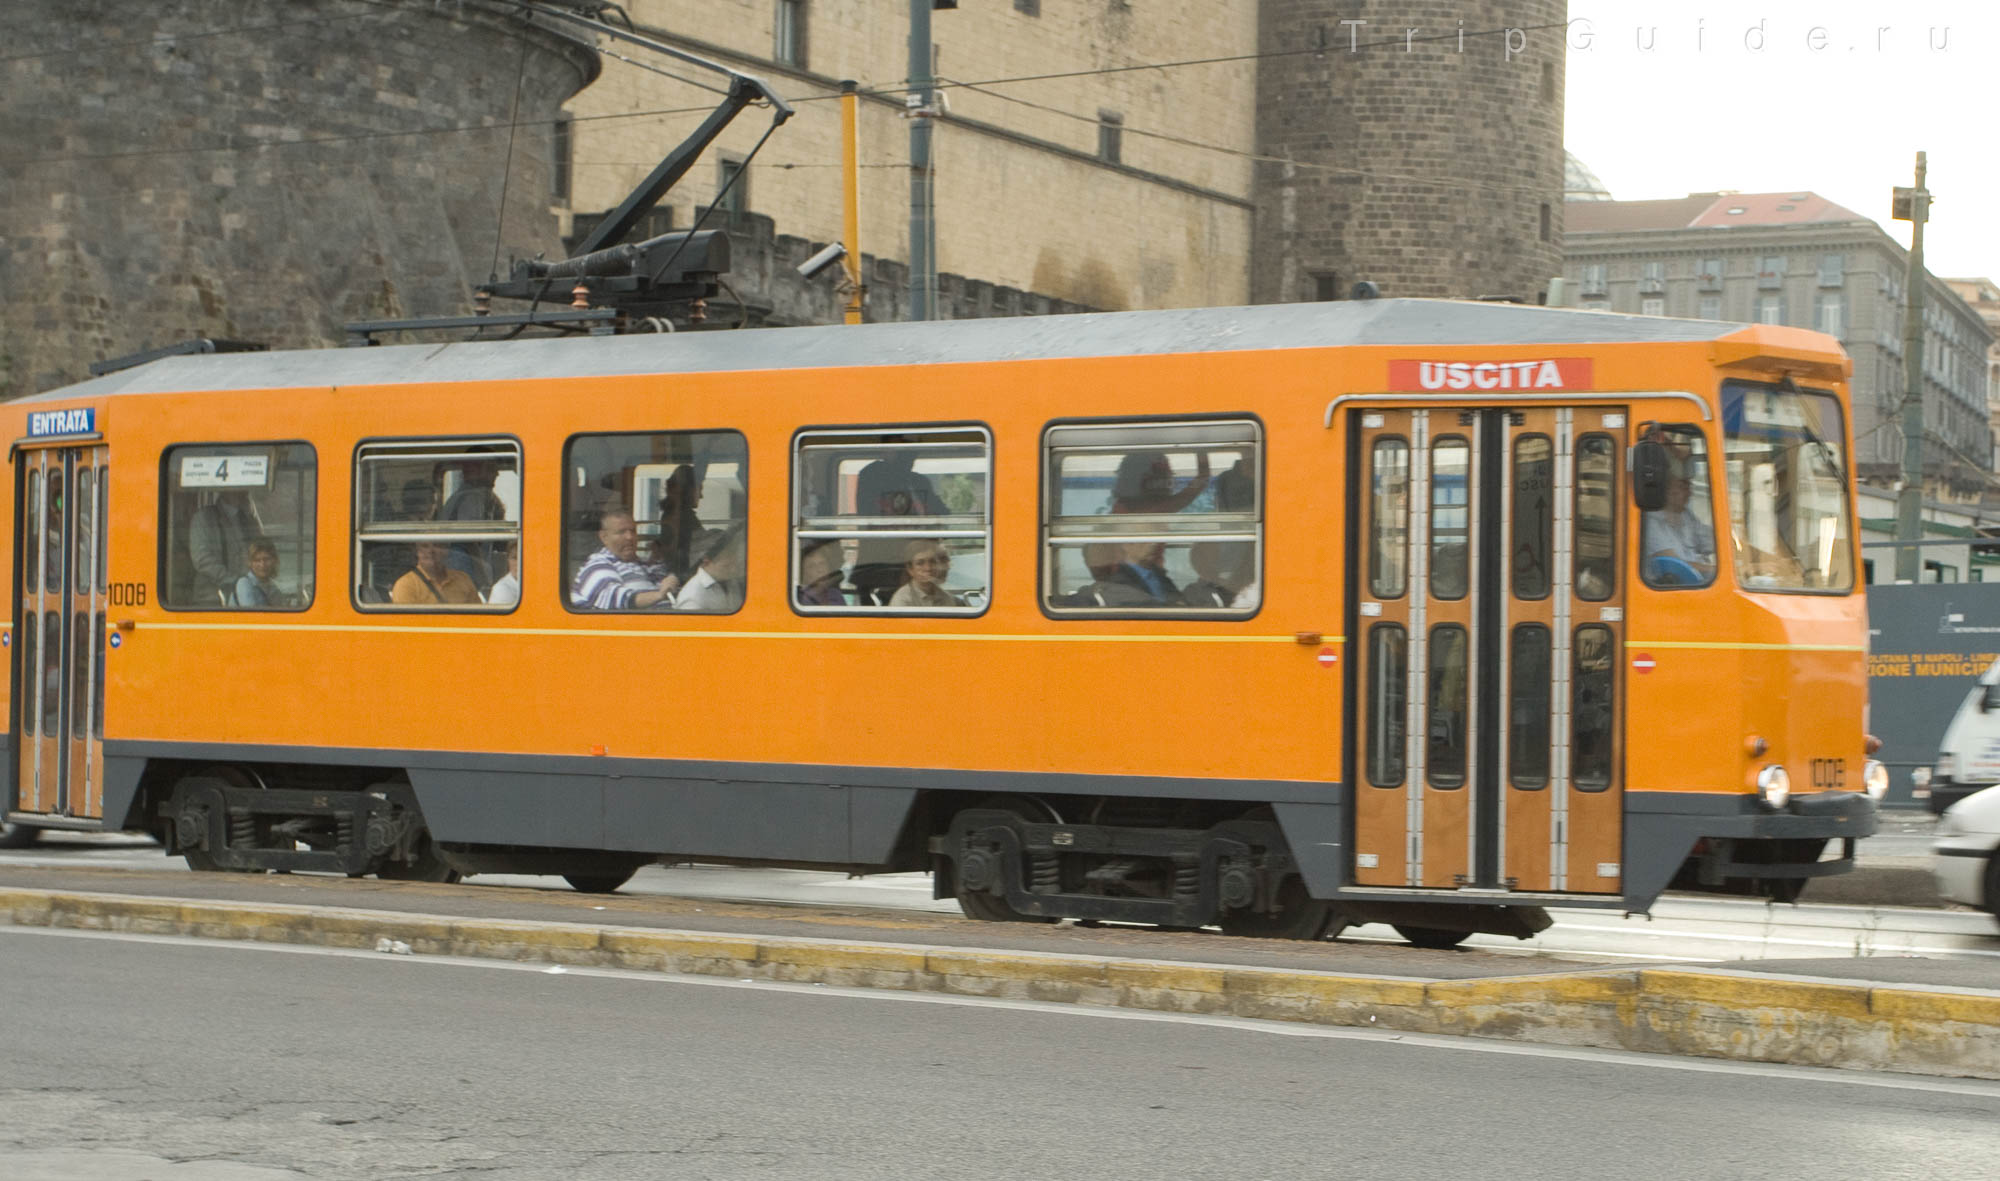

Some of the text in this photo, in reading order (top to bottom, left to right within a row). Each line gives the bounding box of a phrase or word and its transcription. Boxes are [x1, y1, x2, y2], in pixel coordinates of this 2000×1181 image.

[1419, 360, 1564, 389] USCITA
[32, 409, 89, 435] ENTRATA
[215, 459, 228, 481] 4
[107, 582, 146, 606] 1008
